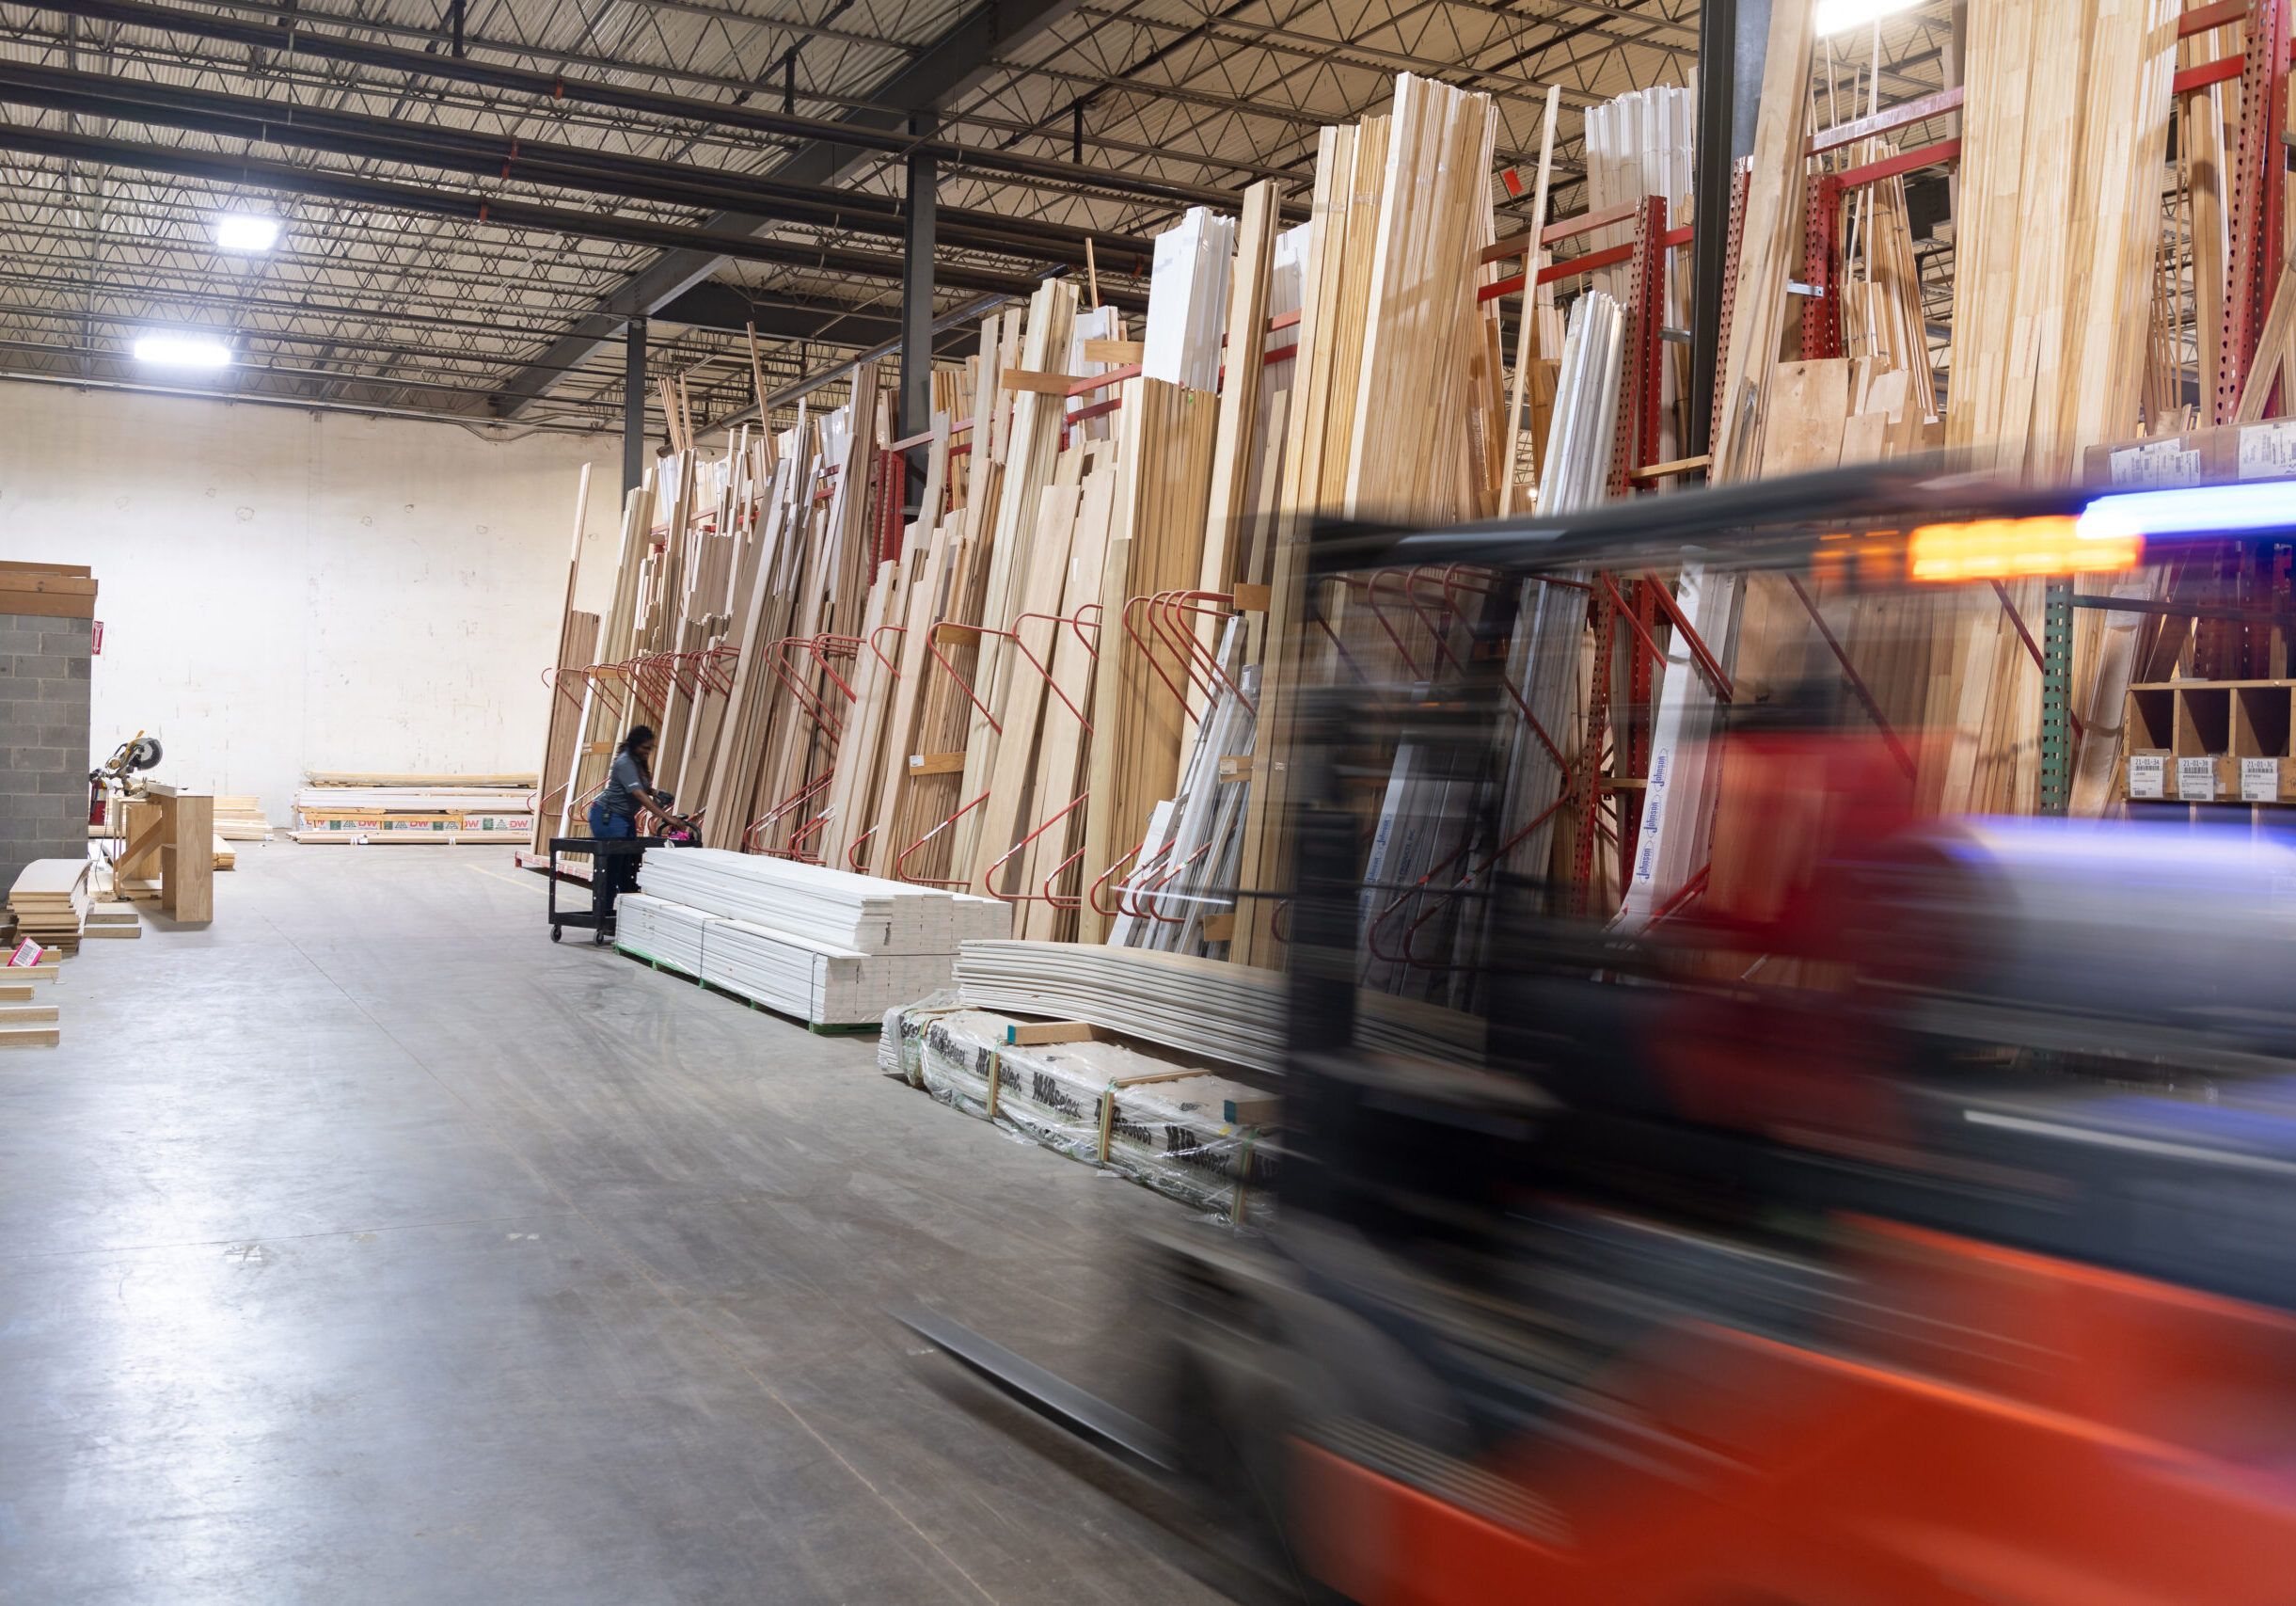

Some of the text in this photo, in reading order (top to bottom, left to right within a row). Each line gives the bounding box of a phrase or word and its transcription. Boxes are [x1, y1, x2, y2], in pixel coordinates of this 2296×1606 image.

[1651, 755, 1667, 787] Johnson
[1644, 802, 1659, 834] Johnson
[1636, 848, 1652, 880] Johnson
